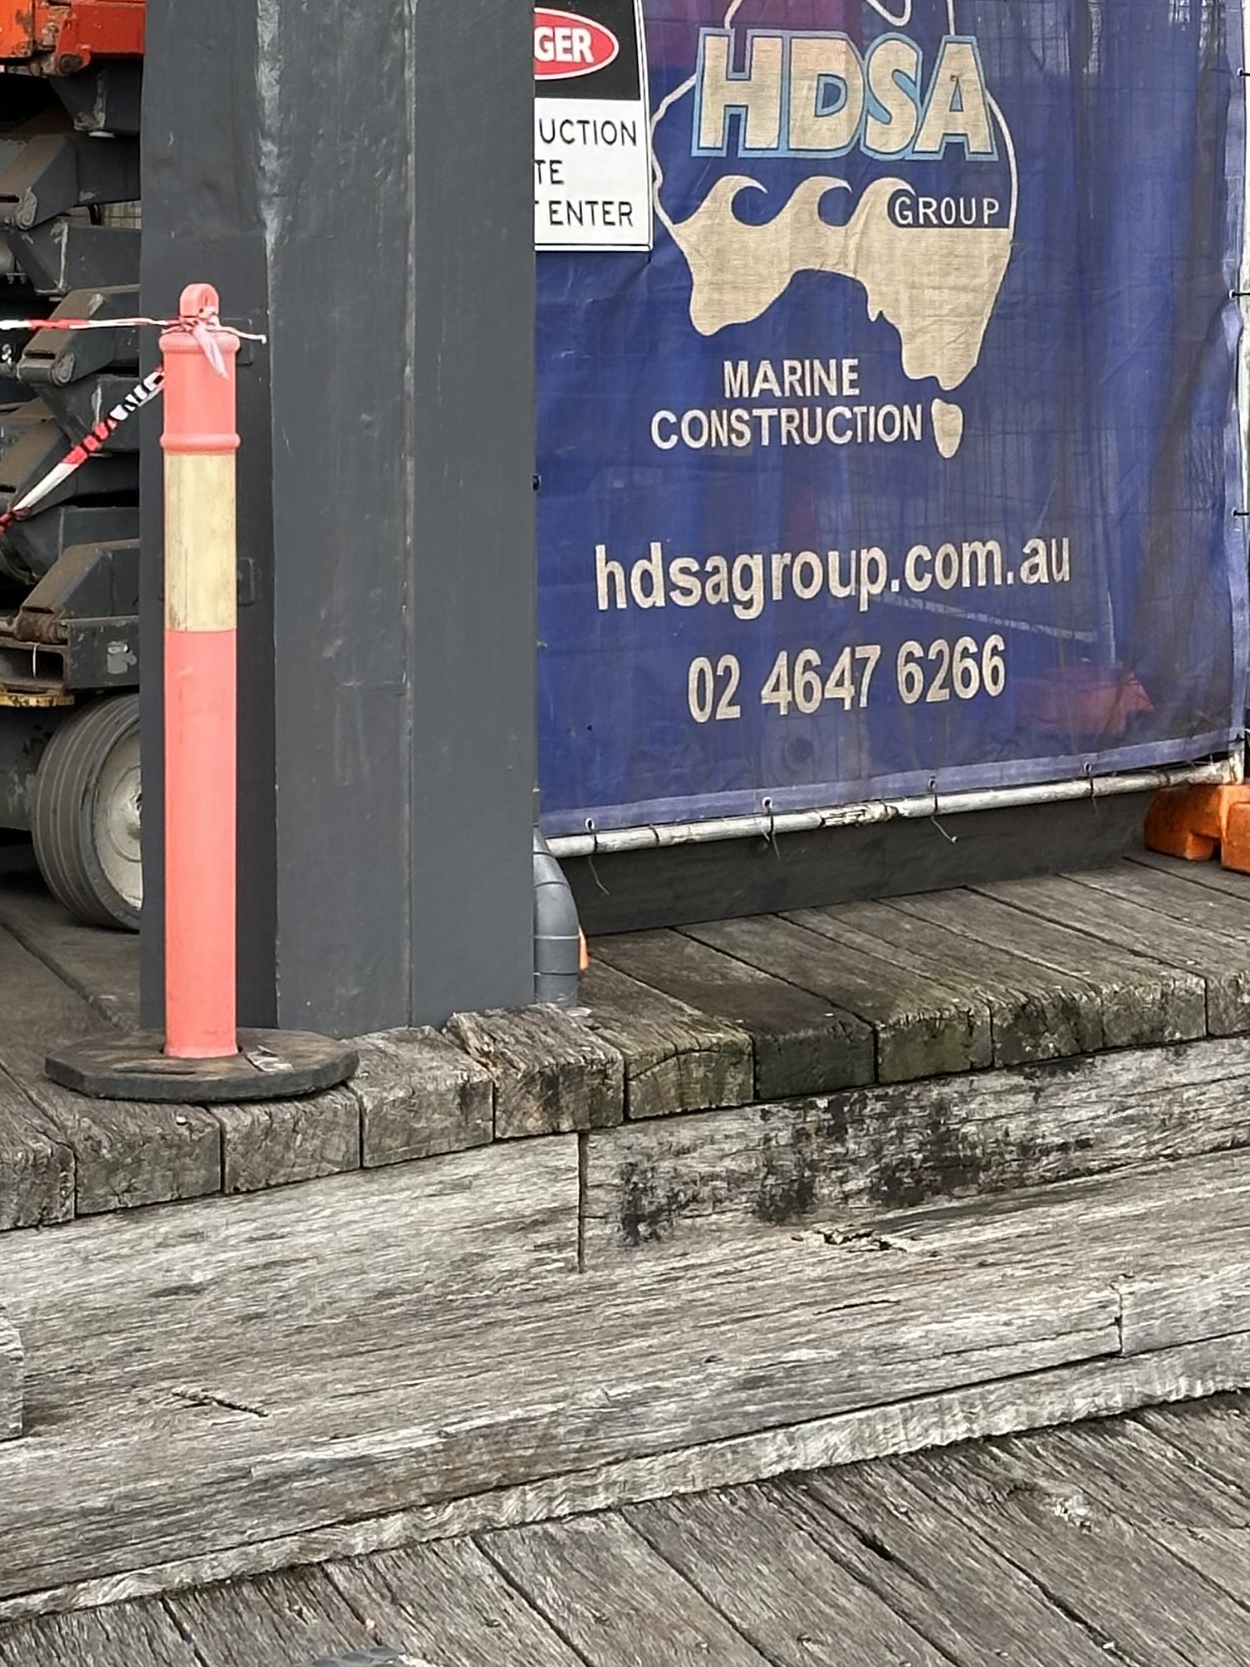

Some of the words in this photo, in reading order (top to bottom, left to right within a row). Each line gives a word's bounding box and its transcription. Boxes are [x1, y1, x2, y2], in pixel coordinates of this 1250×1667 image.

[693, 28, 998, 161] HDSA
[538, 118, 637, 146] UCTION
[548, 200, 633, 227] ENTER
[894, 197, 1000, 226] GROUP
[723, 358, 860, 398] MARINE
[651, 403, 922, 450] CONSTRUCTION
[594, 536, 1070, 620] hdsagroup.com.au
[687, 654, 741, 723] 02
[760, 645, 881, 716] 4647
[896, 634, 1005, 705] 6266
